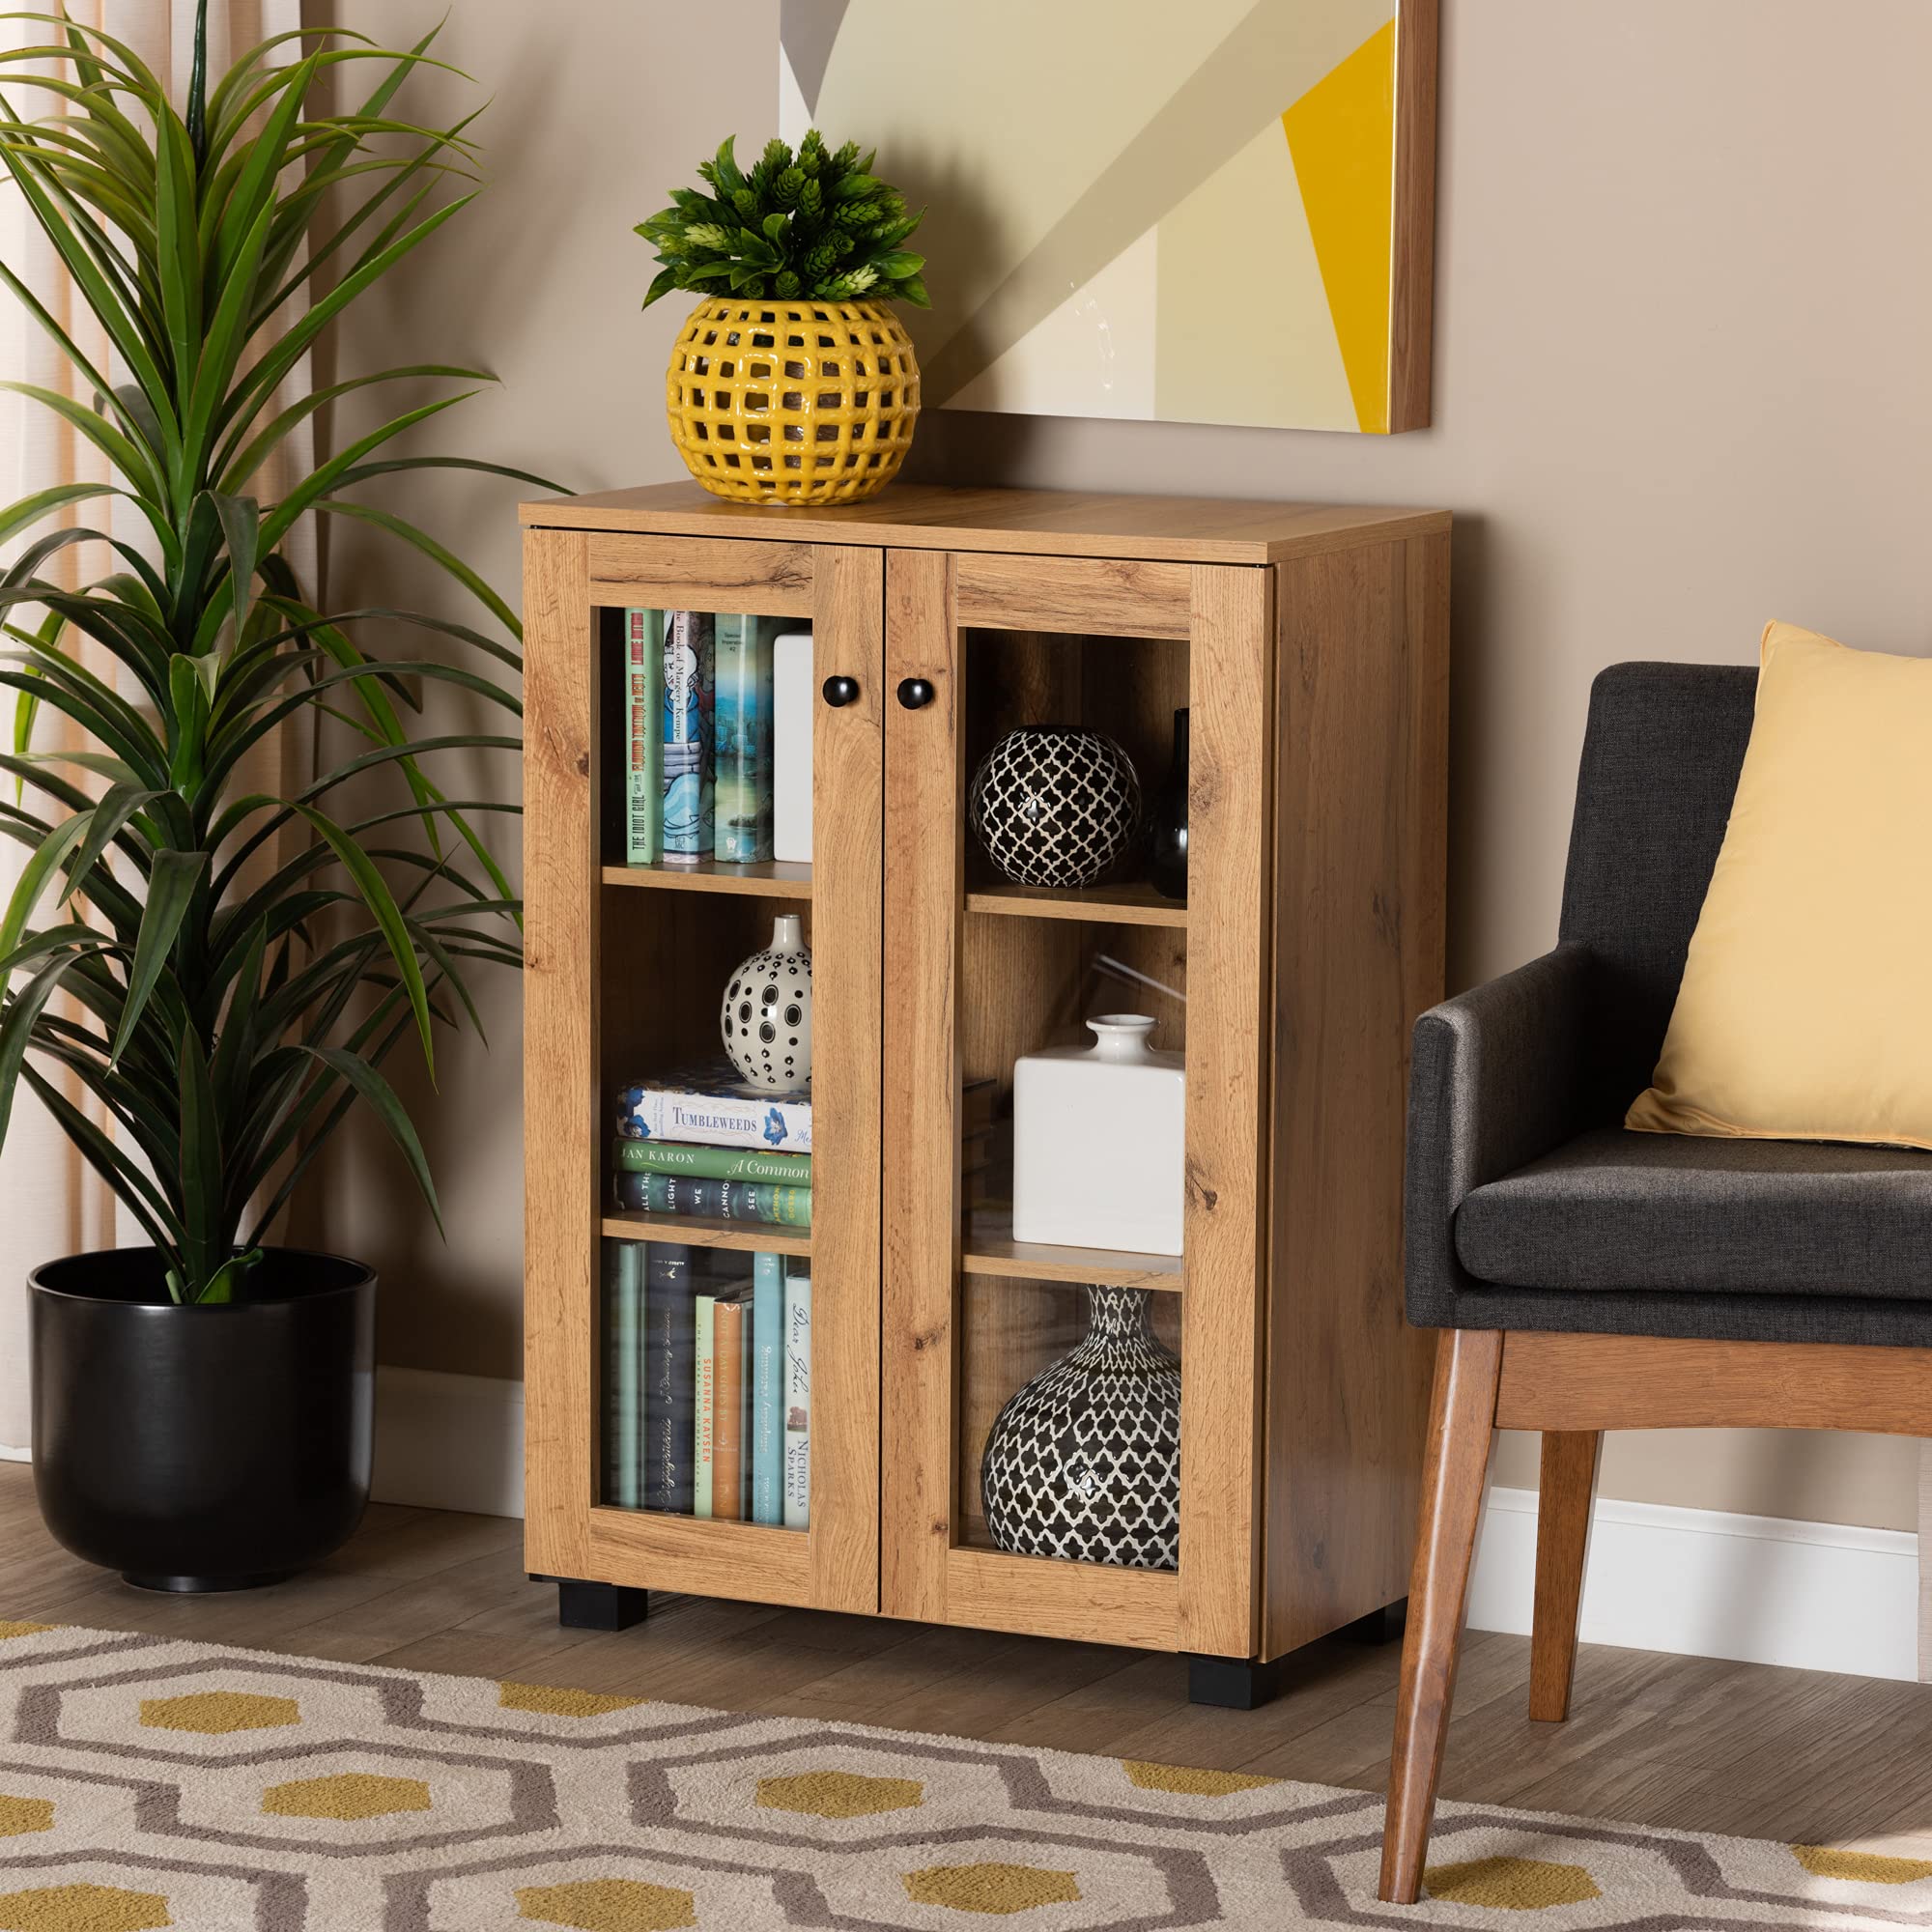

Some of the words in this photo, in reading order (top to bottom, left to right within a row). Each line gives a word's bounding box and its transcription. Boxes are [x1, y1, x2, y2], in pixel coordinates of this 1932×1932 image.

[675, 610, 686, 622] he
[675, 625, 686, 649] Book
[676, 654, 686, 663] of
[674, 663, 685, 707] Margery
[674, 707, 685, 740] Kempe
[632, 794, 646, 813] GIRL
[632, 813, 645, 834] IDIOT
[632, 835, 646, 850] THE
[672, 1106, 757, 1132] TUMBLEWEEDS
[622, 1149, 643, 1159] JAN
[648, 1150, 696, 1164] KARON
[726, 1160, 745, 1176] A
[747, 1160, 810, 1179] Common
[641, 1194, 651, 1211] ALL
[668, 1178, 676, 1209] LIGHT
[694, 1188, 702, 1205] WE
[721, 1179, 732, 1219] CANNO
[773, 1184, 781, 1223] ANTHON
[791, 1302, 810, 1344] Dear
[786, 1344, 810, 1394] John
[702, 1358, 712, 1411] SUSANNA
[702, 1418, 711, 1463] KAYSEN
[787, 1446, 797, 1497] SPARKS
[797, 1439, 809, 1508] NICHOLAS
